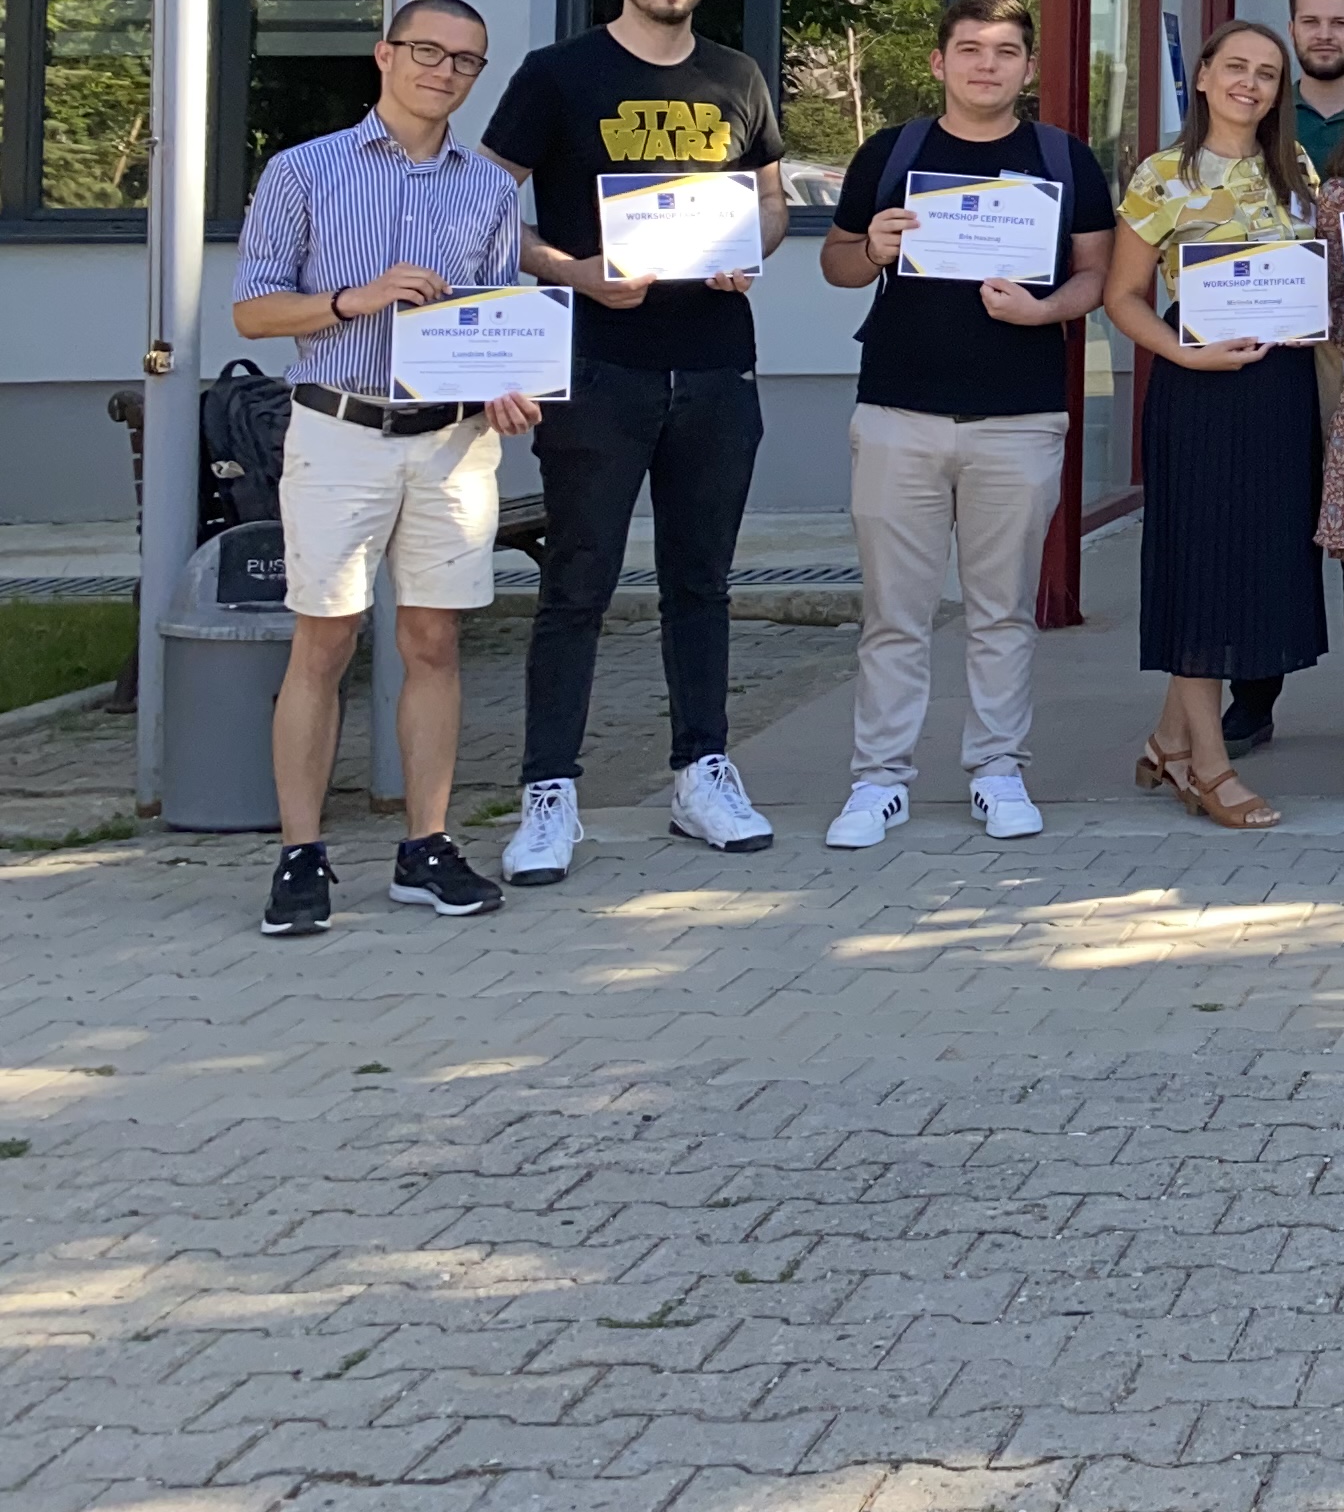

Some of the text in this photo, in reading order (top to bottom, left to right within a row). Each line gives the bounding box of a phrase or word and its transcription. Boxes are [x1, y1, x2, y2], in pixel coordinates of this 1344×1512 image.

[600, 100, 730, 133] STAR
[601, 129, 731, 161] WARS
[928, 211, 1035, 226] WORKSHOP CERTIFICATE
[1203, 277, 1306, 288] WORKSHOP CERTIFICATE
[421, 327, 545, 337] WORKSHOP CERTIFICATE
[246, 558, 287, 574] PUS
